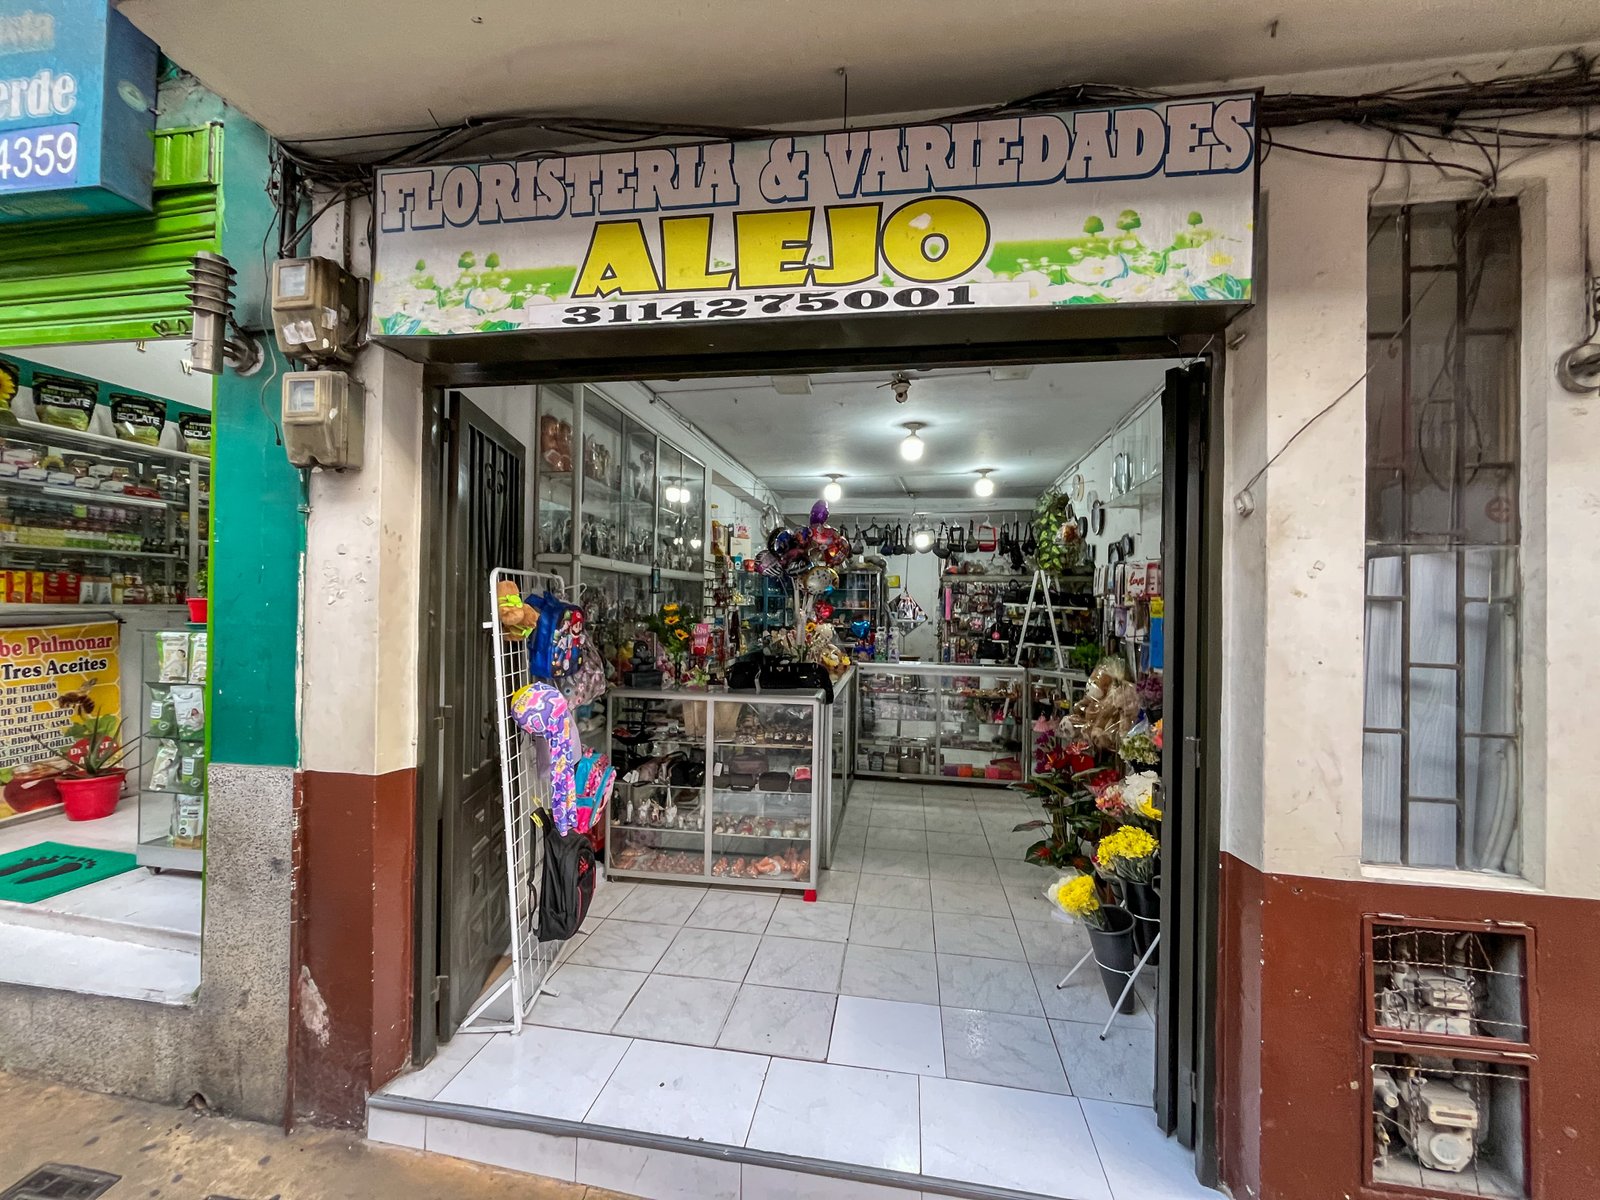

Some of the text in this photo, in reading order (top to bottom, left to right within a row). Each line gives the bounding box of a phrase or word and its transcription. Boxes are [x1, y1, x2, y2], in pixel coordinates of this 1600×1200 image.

[380, 98, 1254, 233] FLORISTERIA & VARIEDADES
[571, 195, 991, 299] ALEJO
[562, 284, 976, 325] 3114275001
[40, 393, 91, 408] ISOLATE
[117, 412, 161, 426] ISOLATE
[27, 636, 113, 655] Pulmonar
[1, 657, 107, 680] Tres Aceites
[6, 686, 17, 695] DE
[21, 682, 57, 693] TIBURON
[6, 696, 17, 705] DE
[21, 692, 58, 703] BACALAO
[0, 708, 74, 726] TO DE EUCALIPTO
[1, 708, 12, 716] DE
[23, 750, 57, 764] REBELD
